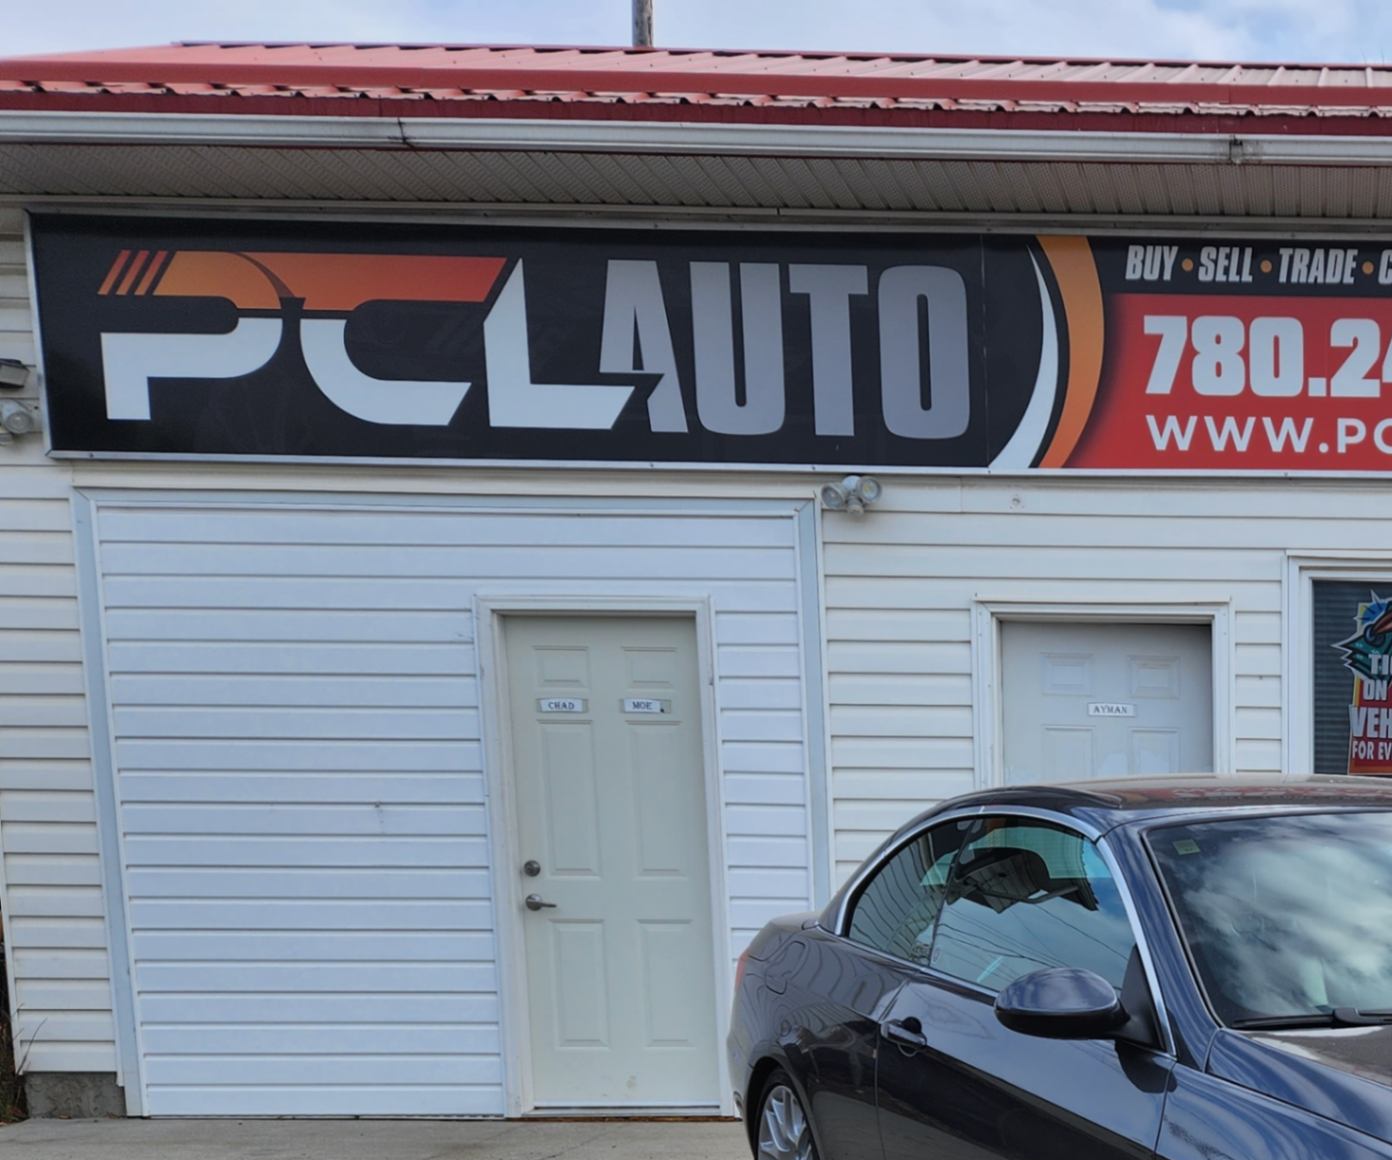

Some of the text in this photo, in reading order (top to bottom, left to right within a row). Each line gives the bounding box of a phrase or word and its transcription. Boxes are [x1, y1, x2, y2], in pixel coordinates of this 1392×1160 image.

[1124, 245, 1179, 281] BUY
[1198, 246, 1254, 283] SELL
[1278, 247, 1358, 284] TRADE
[1362, 679, 1388, 701] ON
[547, 701, 576, 711] CHAD
[631, 701, 654, 711] MOE
[1093, 704, 1128, 714] AYMAN
[1351, 740, 1375, 760] FOR
